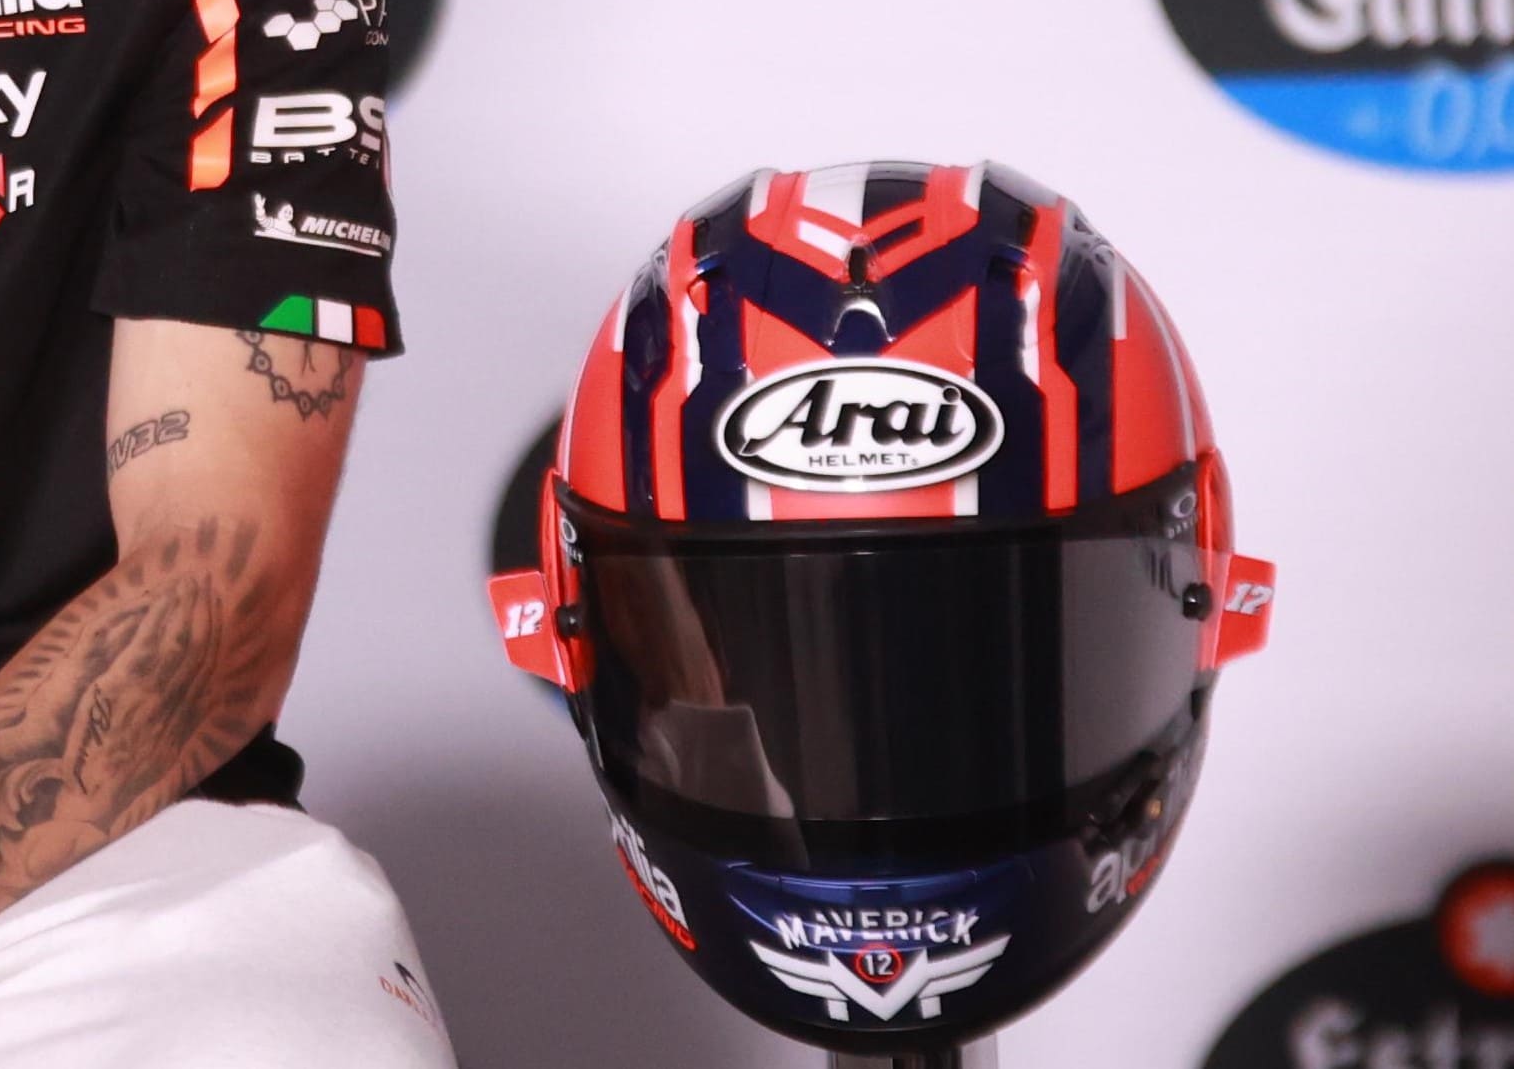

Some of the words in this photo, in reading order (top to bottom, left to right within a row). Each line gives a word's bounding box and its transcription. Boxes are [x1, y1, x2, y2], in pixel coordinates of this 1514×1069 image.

[250, 147, 379, 169] BATTE
[739, 380, 966, 455] Arai
[808, 452, 911, 467] HELMET
[1224, 583, 1274, 615] 12
[504, 600, 545, 639] 12
[775, 906, 980, 951] MAVERICK
[863, 953, 894, 976] 12
